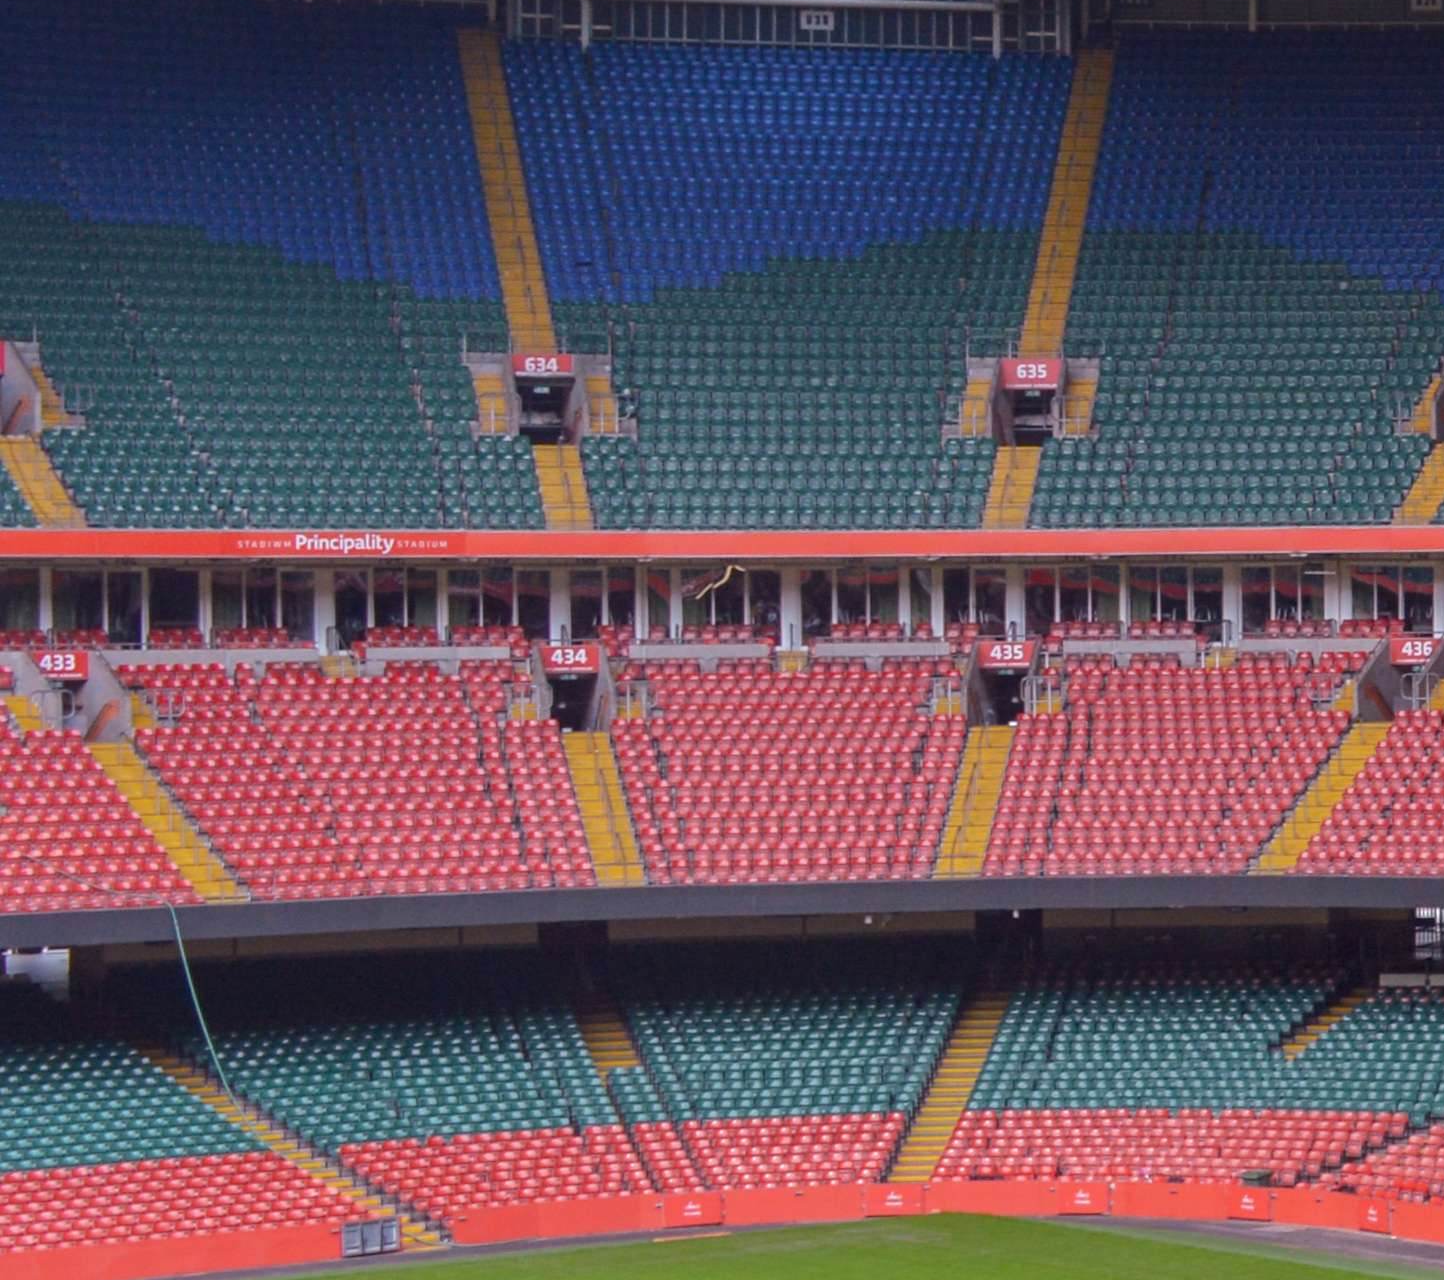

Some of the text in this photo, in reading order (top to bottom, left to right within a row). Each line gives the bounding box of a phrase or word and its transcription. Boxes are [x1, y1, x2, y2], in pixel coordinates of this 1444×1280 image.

[524, 357, 558, 373] 634
[1016, 363, 1047, 380] 635
[295, 533, 394, 555] Principality
[550, 648, 588, 665] 434
[990, 644, 1024, 661] 435
[1401, 640, 1432, 656] 436
[39, 653, 76, 671] 433
